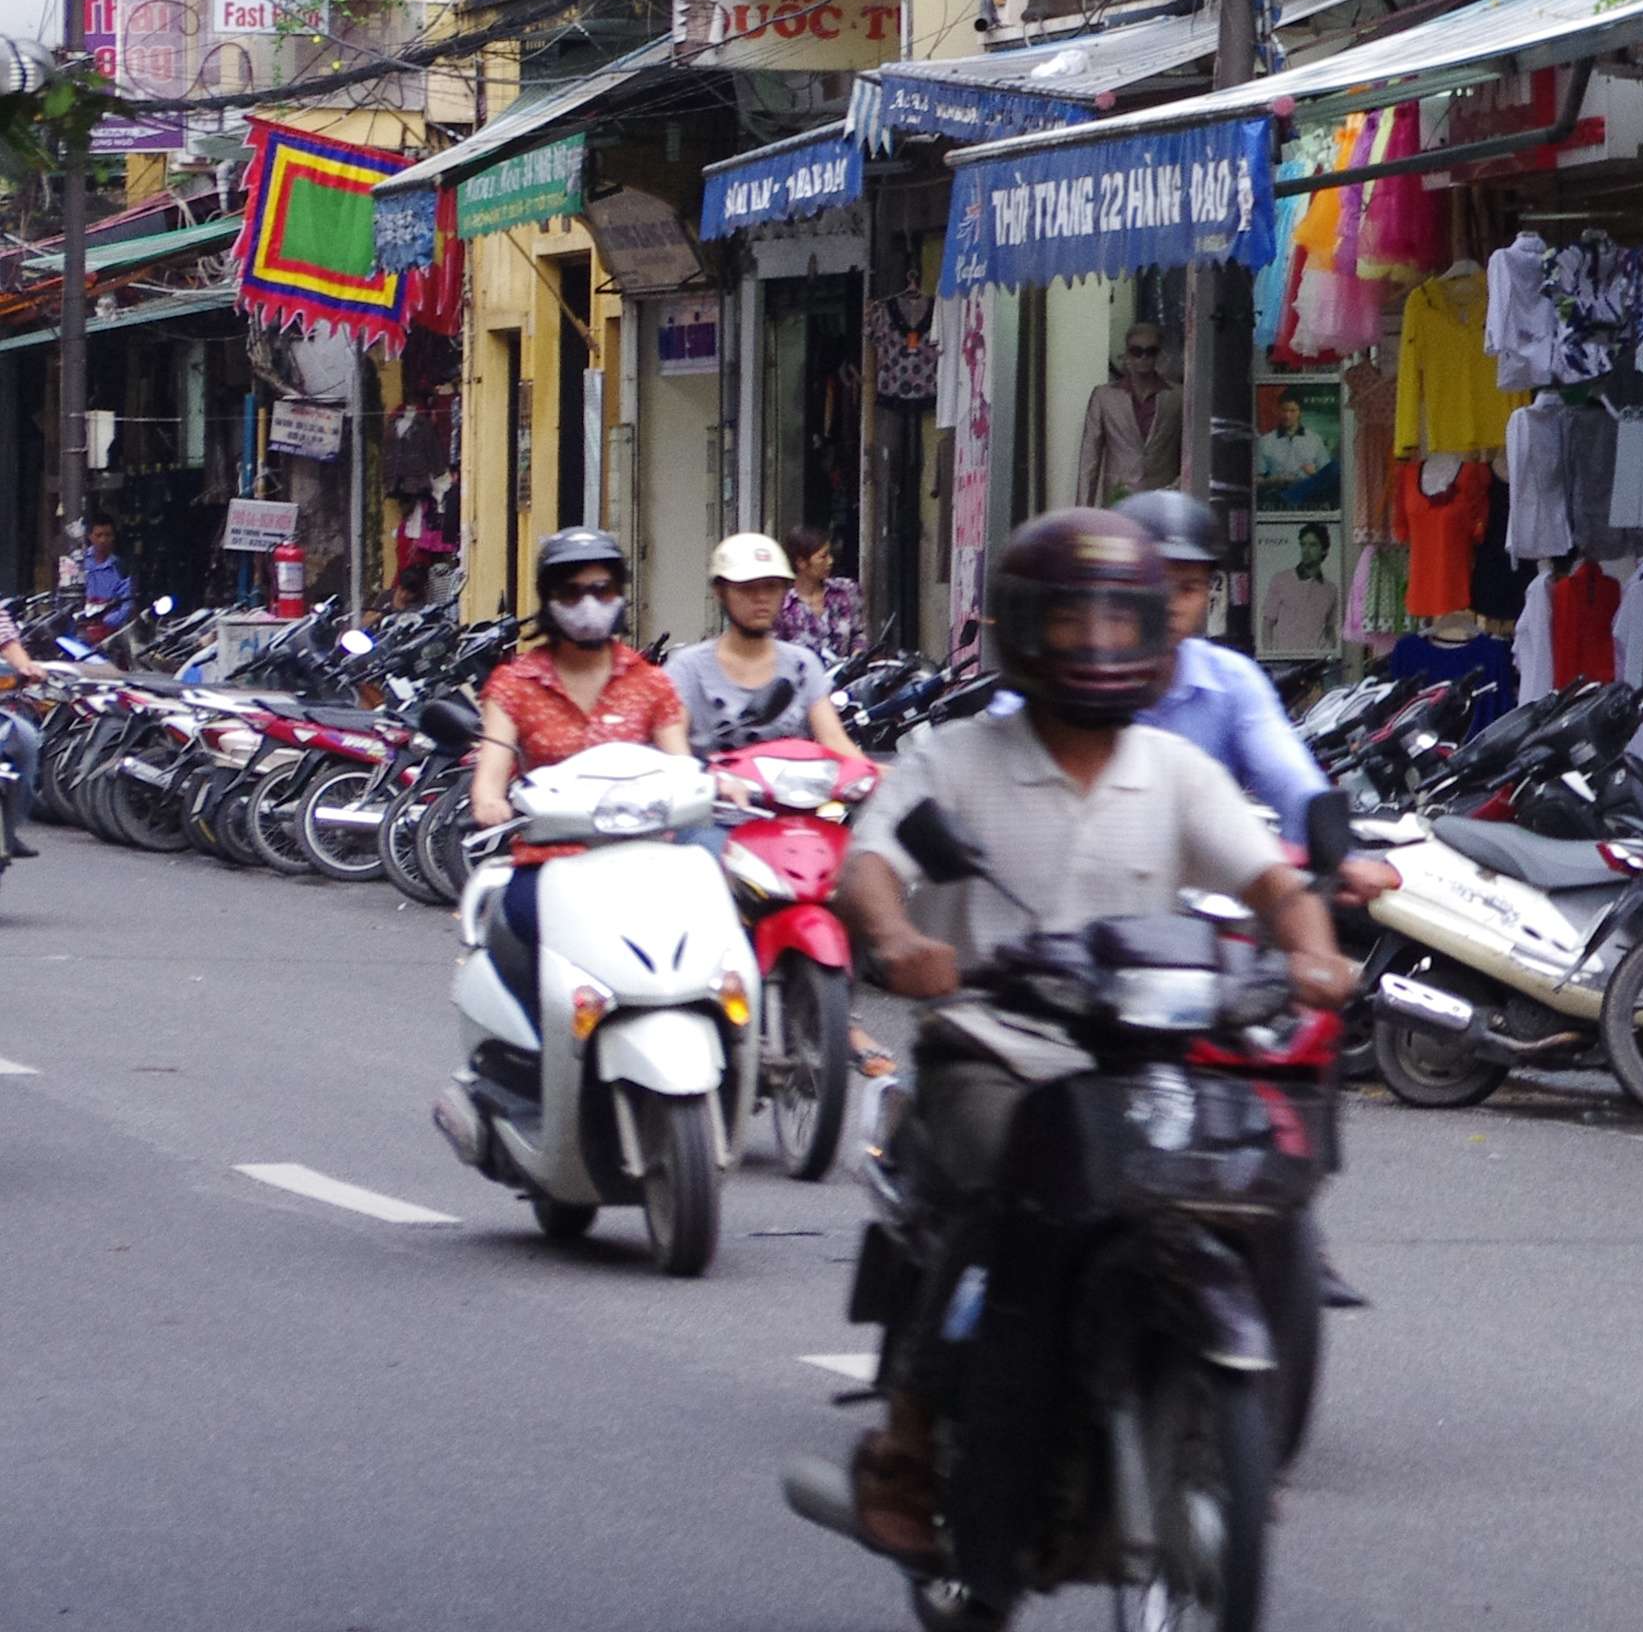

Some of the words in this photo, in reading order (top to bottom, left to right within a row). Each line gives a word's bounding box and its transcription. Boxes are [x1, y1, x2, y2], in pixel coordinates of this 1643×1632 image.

[223, 1, 265, 28] Fast
[1099, 171, 1125, 233] 22
[1126, 153, 1182, 230] HÀNG
